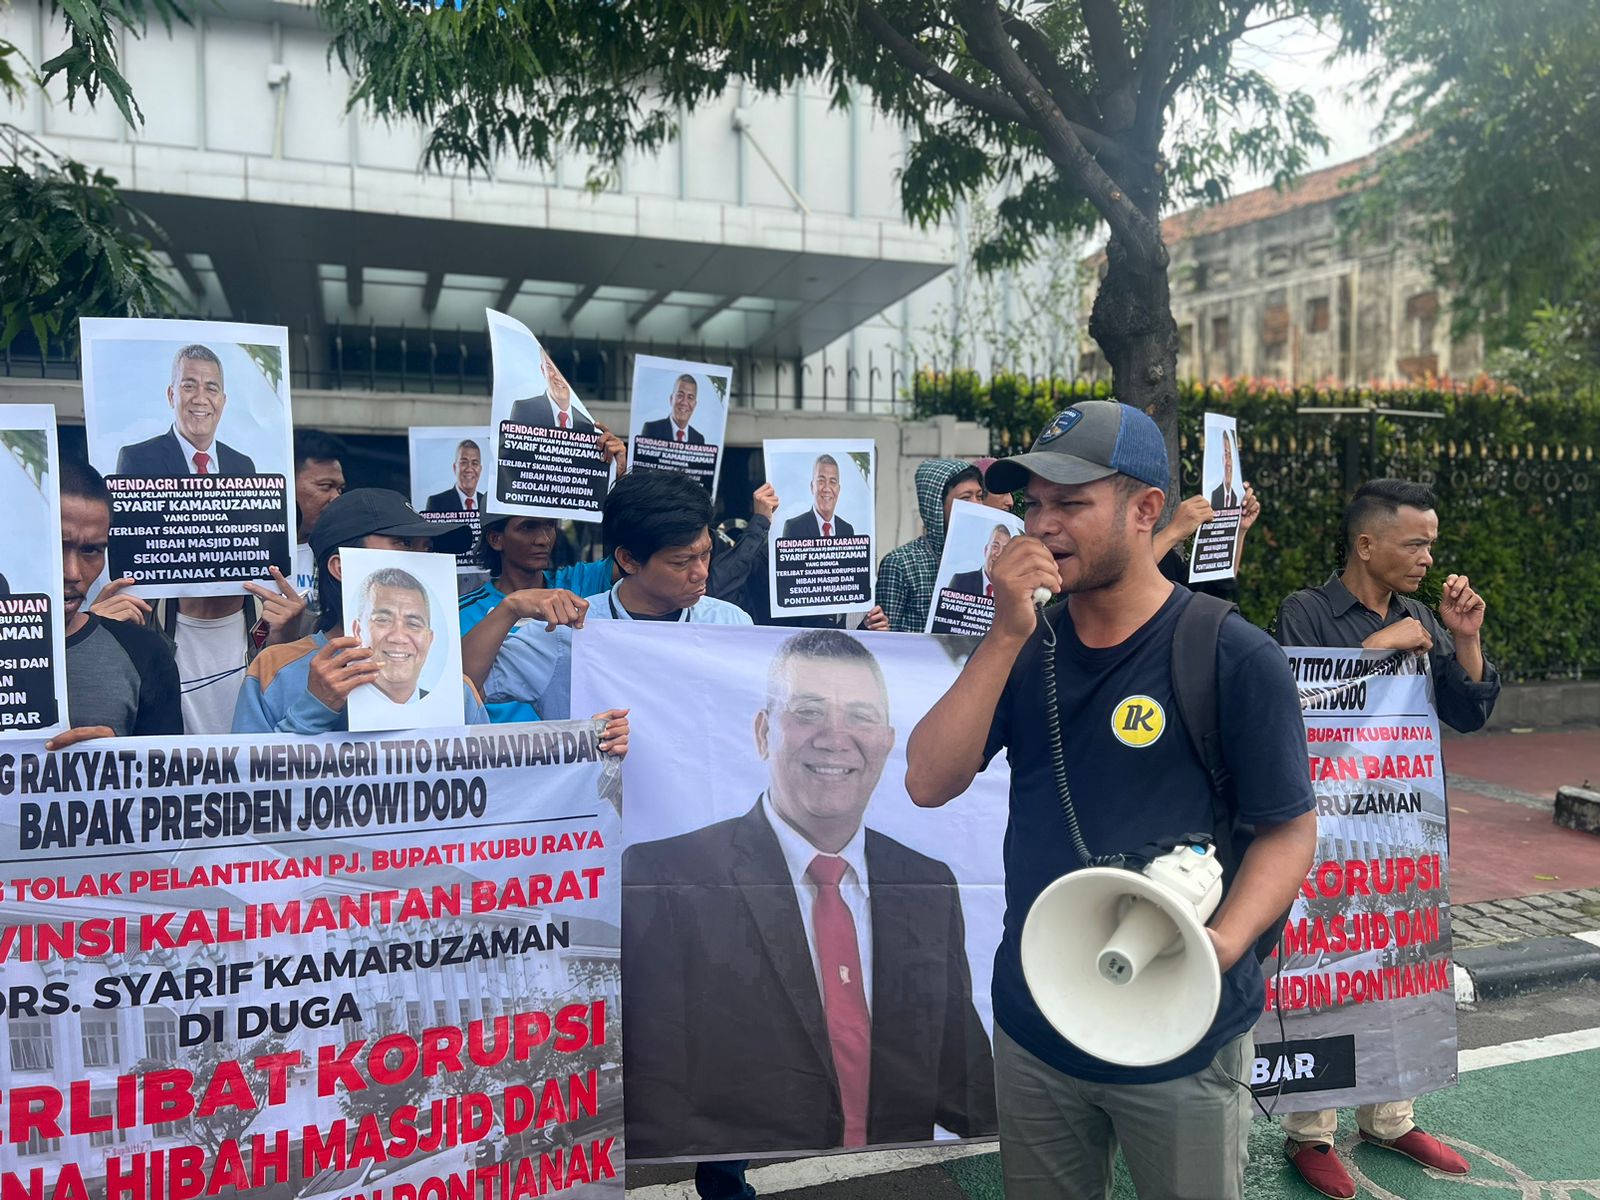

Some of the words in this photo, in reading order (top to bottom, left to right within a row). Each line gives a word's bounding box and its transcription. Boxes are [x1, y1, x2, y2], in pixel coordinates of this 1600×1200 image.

[502, 424, 547, 437] MENDAGRI
[549, 430, 568, 440] TITO
[505, 440, 538, 450] SYARIF
[499, 459, 531, 469] TERLIBAT
[532, 462, 562, 472] SKANDAL
[564, 466, 591, 475] KORUPSI
[106, 479, 178, 490] MENDAGRI
[180, 478, 213, 489] TITO
[217, 478, 284, 489] KARAVIAN
[520, 471, 544, 480] HIBAH
[546, 474, 570, 484] MASJID
[571, 477, 588, 485] DAN
[111, 491, 140, 499] TOLAK
[194, 491, 203, 499] PJ
[512, 481, 549, 491] SEKOLAH
[551, 486, 593, 496] MUJAHIDIN
[113, 501, 165, 512] SYARIF
[170, 500, 281, 511] KAMARUZAMAN
[505, 493, 558, 504] PONTIANAK
[561, 498, 598, 508] KALBAR
[163, 514, 190, 522] YANG
[109, 527, 160, 536] TERLIBAT
[162, 526, 213, 535] SKANDAL
[216, 525, 262, 534] KORUPSI
[264, 524, 285, 532] DAN
[146, 540, 185, 549] HIBAH
[188, 538, 230, 548] MASJID
[233, 537, 259, 547] DAN
[833, 537, 869, 545] KARAVIAN
[134, 553, 196, 564] SEKOLAH
[199, 550, 269, 563] MUJAHIDIN
[780, 553, 807, 561] SYARIF
[809, 551, 867, 560] KAMARUZAMAN
[123, 569, 215, 580] PONTIANAK
[220, 566, 270, 577] KALBA
[823, 584, 859, 592] MUJAHIDIN
[785, 596, 831, 605] PONTIANAK
[833, 594, 865, 602] KALBAR
[941, 590, 976, 602] MENDAGRI
[977, 597, 992, 605] TITO
[941, 603, 967, 613] SYARIF
[14, 615, 42, 623] RAYA
[0, 626, 43, 640] MAN
[20, 658, 49, 669] DAN
[1303, 658, 1332, 682] TITO
[0, 712, 40, 726] BAR
[1307, 728, 1354, 742] BUPATI
[1358, 727, 1400, 742] KUBU
[1402, 727, 1432, 740] RAYA
[21, 750, 142, 794] RAKYAT:
[148, 746, 240, 788] BAPAK
[249, 740, 377, 783] MENDAGRI
[380, 738, 432, 776] TITO
[435, 733, 561, 772] KARNAVIAN
[1362, 755, 1434, 779] BARAT
[1316, 792, 1422, 816] RUZAMAN
[20, 798, 135, 850] BAPAK
[141, 788, 292, 843] PRESIDEN
[297, 780, 408, 832] JOKOWI
[413, 776, 487, 821] DODO
[11, 872, 123, 901] TOLAK
[129, 856, 322, 894] PELANTIKAN
[328, 852, 366, 876] PJ.
[372, 843, 465, 872] BUPATI
[470, 836, 537, 861] KUBU
[541, 830, 604, 855] RAYA
[140, 883, 461, 951] KALIMANTAN
[471, 867, 605, 913] BARAT
[1285, 912, 1391, 957] MASJID
[1394, 906, 1439, 947] DAN
[93, 961, 254, 1010] SYARIF
[264, 921, 570, 989] KAMARUZAMAN
[1336, 959, 1449, 1004] PONTIANAK
[179, 1010, 225, 1047] DI
[237, 992, 363, 1040] DUGA
[0, 1049, 303, 1144] RLIBAT
[317, 999, 607, 1097] KORUPSI
[1251, 1052, 1315, 1085] BAR
[106, 1129, 290, 1200] HIBAH
[302, 1091, 494, 1179] MASJID
[503, 1069, 598, 1136] DAN
